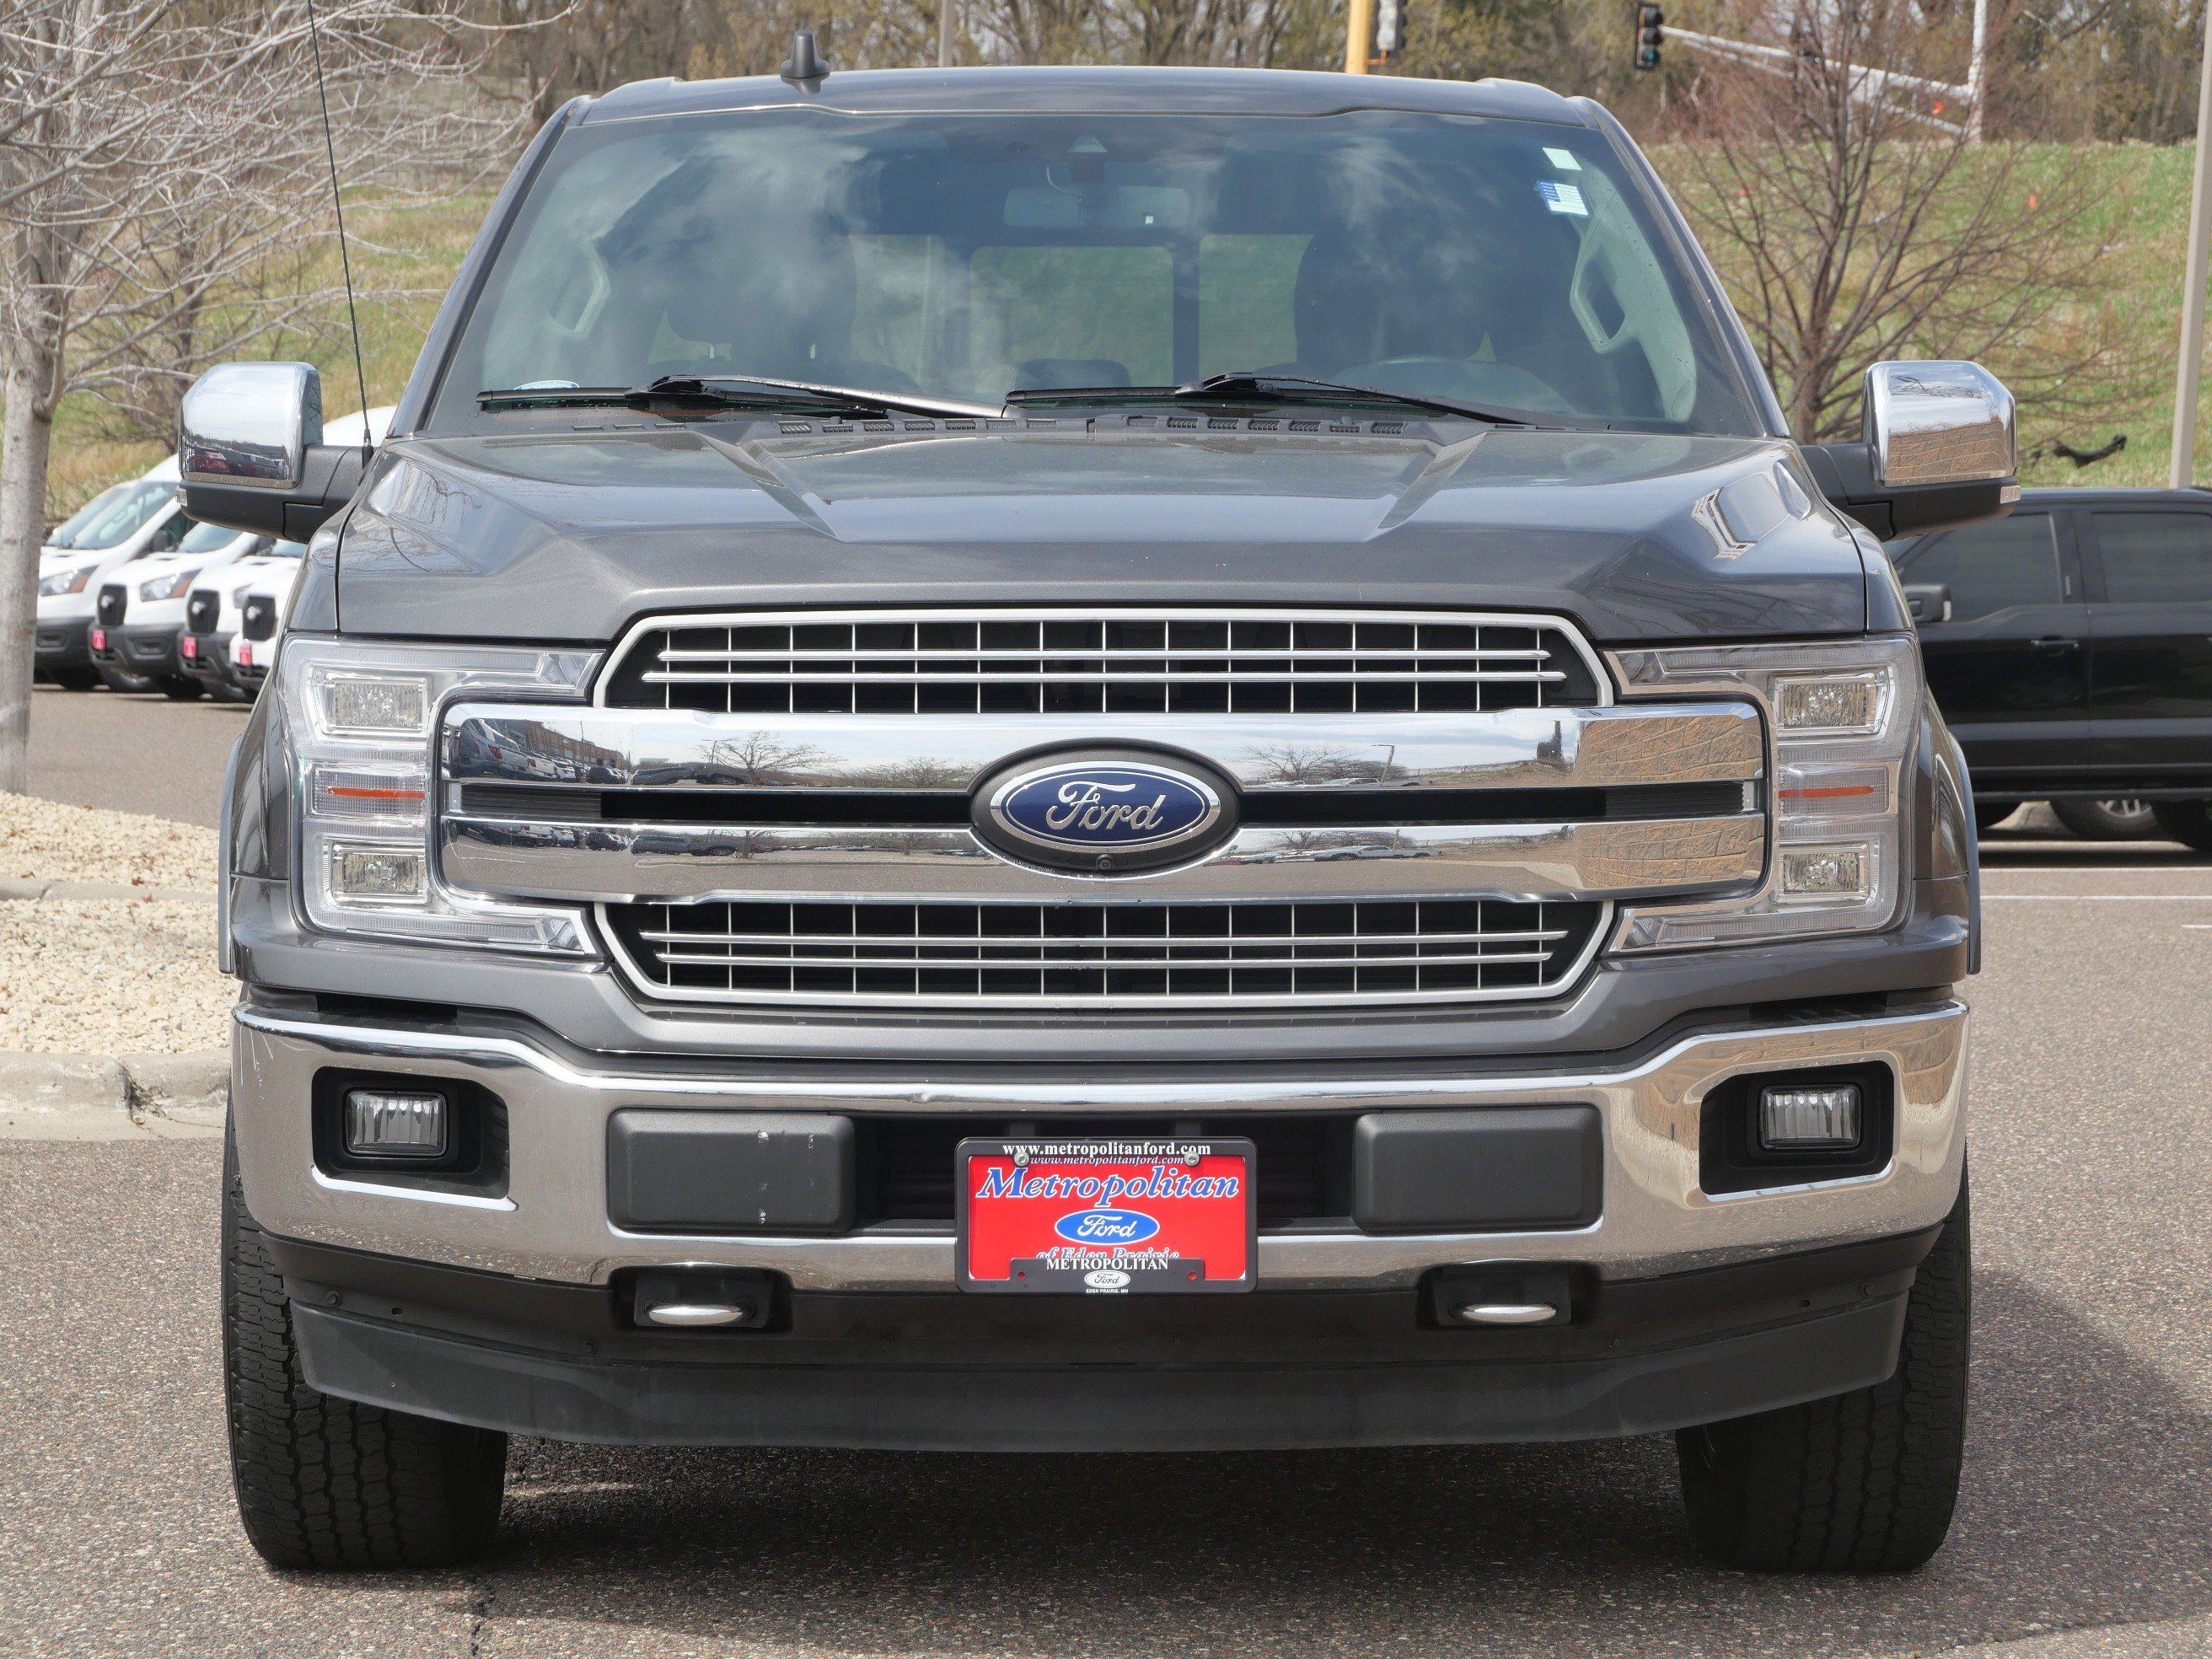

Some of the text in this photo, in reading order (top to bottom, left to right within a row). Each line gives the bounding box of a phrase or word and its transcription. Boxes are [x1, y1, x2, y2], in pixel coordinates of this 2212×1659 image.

[1045, 781, 1167, 830] Ford
[1002, 1142, 1211, 1158] www.metropolitanford.com
[1030, 1155, 1184, 1168] www.metropolitanford.com
[975, 1166, 1239, 1208] Metropolitan
[1076, 1215, 1138, 1238] Ford
[1046, 1258, 1169, 1270] METROPOLITAN
[1094, 1273, 1120, 1284] Ford
